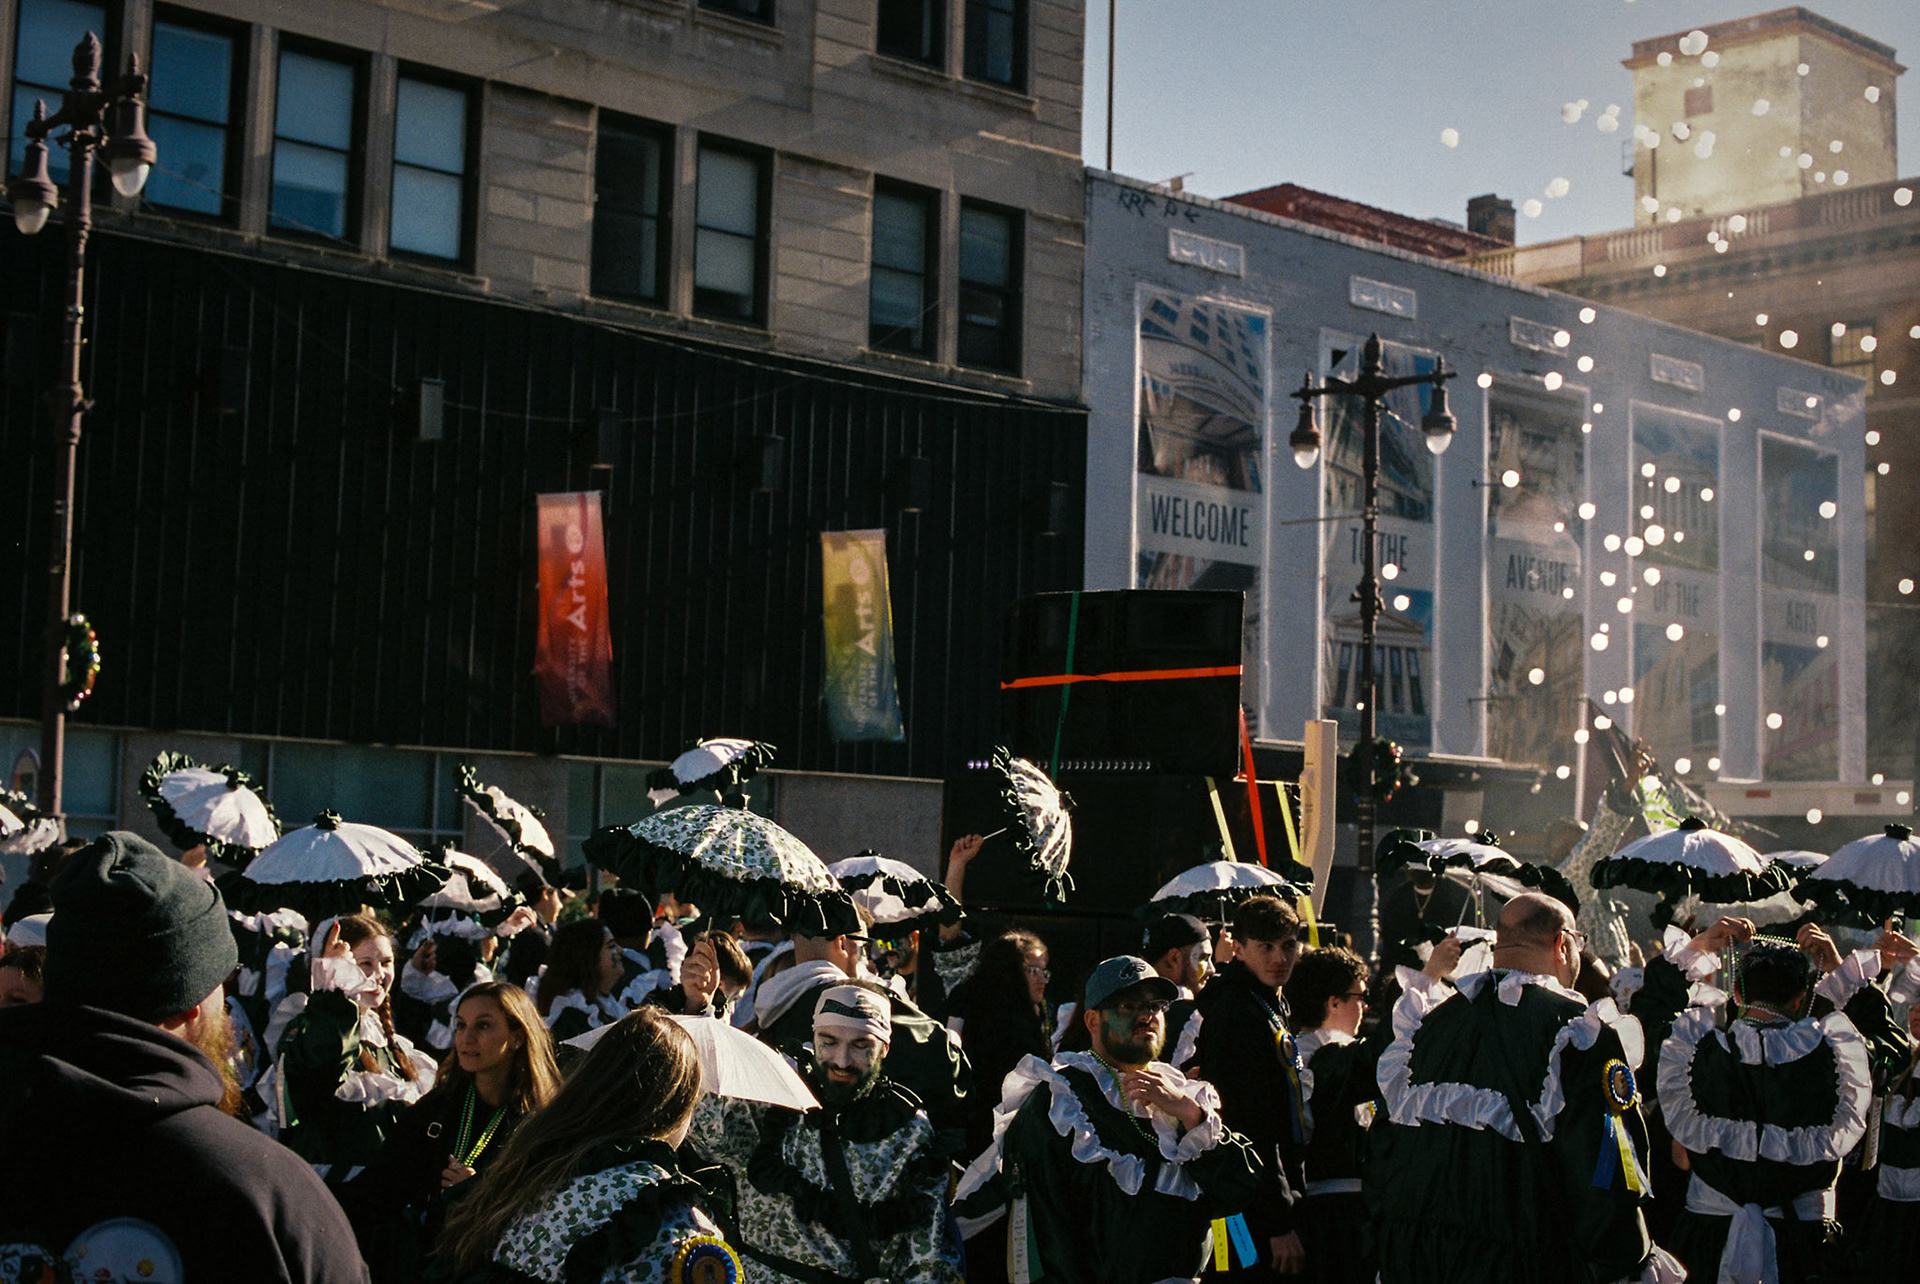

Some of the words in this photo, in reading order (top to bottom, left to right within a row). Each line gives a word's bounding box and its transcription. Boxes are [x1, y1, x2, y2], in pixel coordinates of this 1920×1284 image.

[1151, 493, 1249, 547] WELCOME
[1378, 531, 1407, 573] THE
[565, 560, 588, 632] Arts
[1506, 554, 1568, 596] AVENUE
[1653, 579, 1671, 612] OF
[1675, 581, 1700, 618] THE
[1785, 599, 1818, 636] ARTS
[855, 590, 877, 656] Arts
[868, 662, 879, 685] THE
[868, 691, 879, 708] OF
